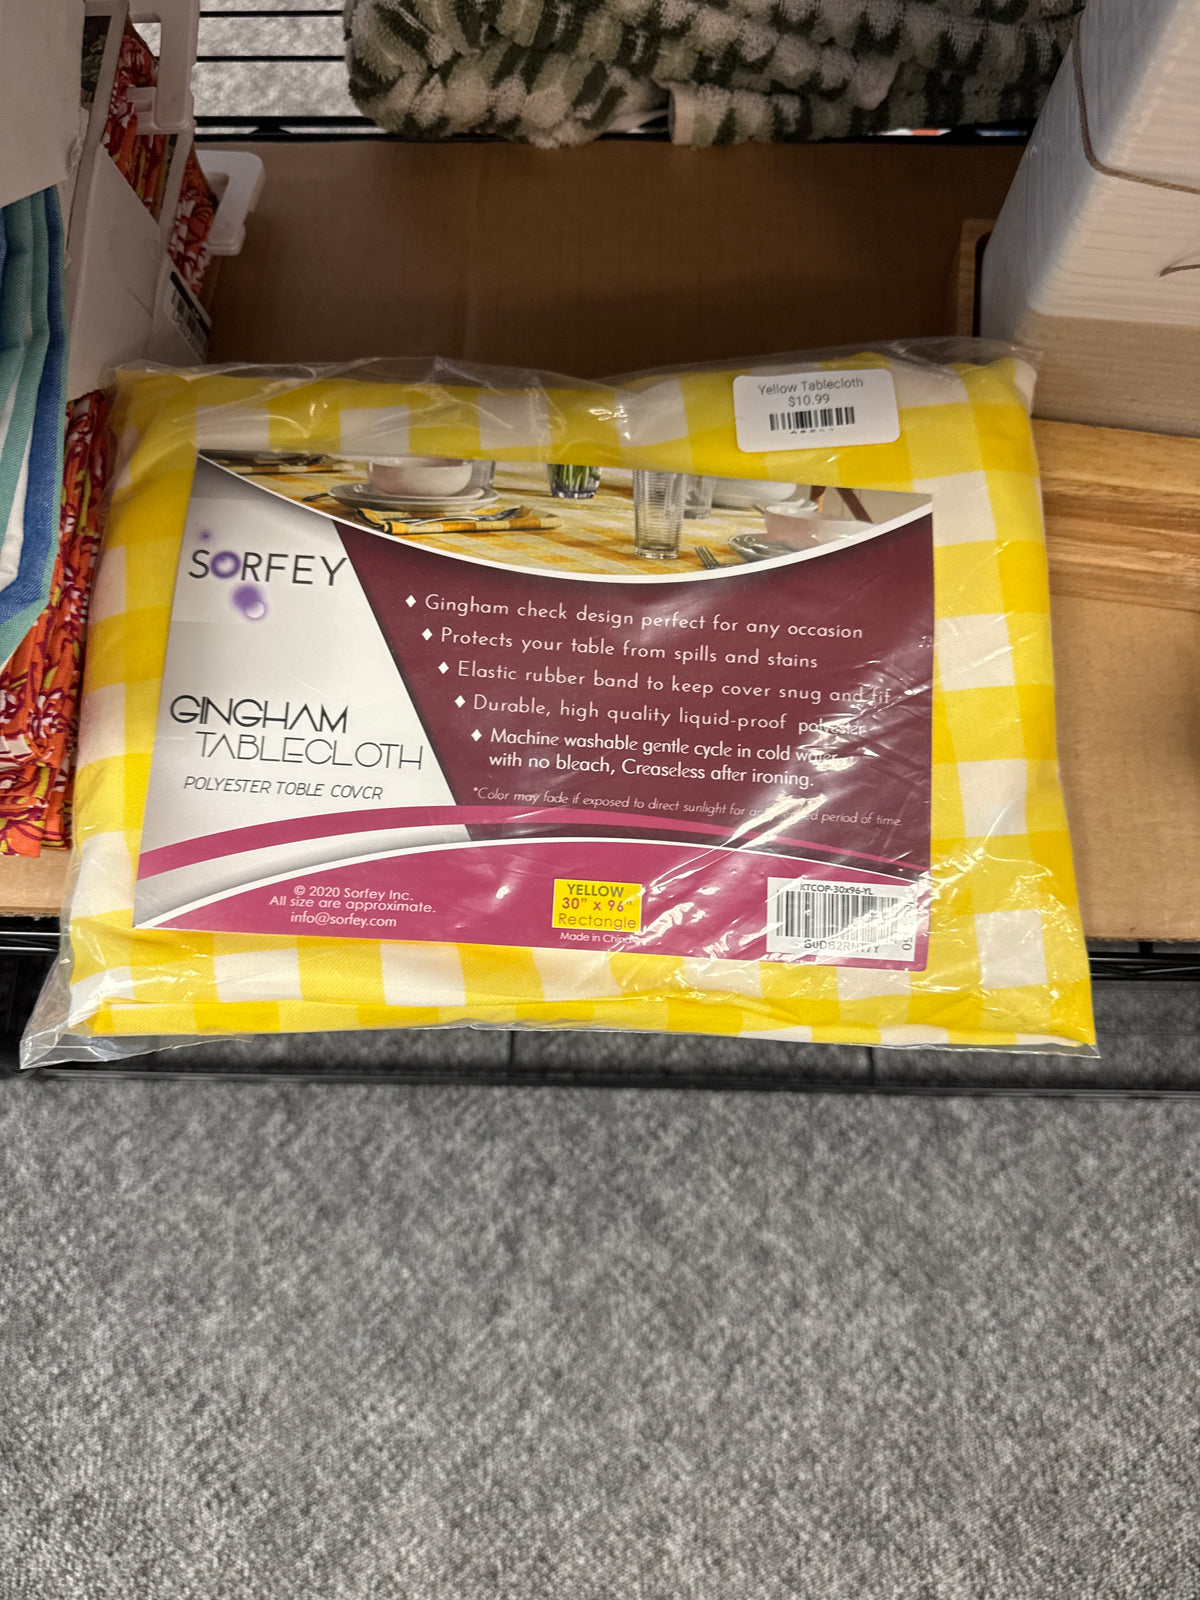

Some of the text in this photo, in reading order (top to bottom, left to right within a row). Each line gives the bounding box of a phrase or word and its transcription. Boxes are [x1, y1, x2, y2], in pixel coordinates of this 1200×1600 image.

[758, 377, 864, 396] Yellow Tablecloth
[788, 393, 830, 407] $10.99
[188, 549, 347, 586] SORFEY
[425, 594, 863, 640] Gingham check design perfect for any occasion
[441, 627, 818, 668] Protects your table from spills and stains
[458, 660, 891, 705] Elastic rubber band to keep cover snug and fit
[170, 695, 348, 733] GINGHAM
[474, 694, 551, 717] Durable,
[560, 699, 599, 722] high
[607, 705, 671, 726] quality
[679, 707, 787, 729] liquid-proof
[195, 731, 423, 770] TABLECLOTH
[490, 728, 559, 746] Machine
[564, 734, 638, 751] washable
[643, 738, 689, 755] gentle
[694, 741, 732, 759] cycle
[737, 743, 751, 759] in
[756, 745, 791, 761] cold
[489, 752, 814, 790] with no bleach, Creaseless after ironing.
[184, 776, 271, 796] POLYESTER
[514, 793, 540, 805] may
[543, 791, 569, 804] fade
[572, 793, 582, 804] if
[583, 796, 630, 809] exposed
[634, 798, 645, 809] to
[648, 797, 679, 811] direct
[683, 799, 727, 816] sunlight
[729, 801, 746, 815] for
[821, 811, 858, 826] period
[861, 812, 874, 823] of
[309, 886, 341, 898] 2020
[344, 888, 385, 901] Sorfey
[389, 889, 414, 901] Inc.
[567, 884, 624, 897] YELLOW
[269, 895, 436, 913] All size are approximate.
[593, 902, 601, 911] x
[290, 911, 397, 929] info@sorfey.com
[558, 913, 636, 930] Rectangle
[560, 932, 590, 941] Made
[592, 933, 600, 942] in
